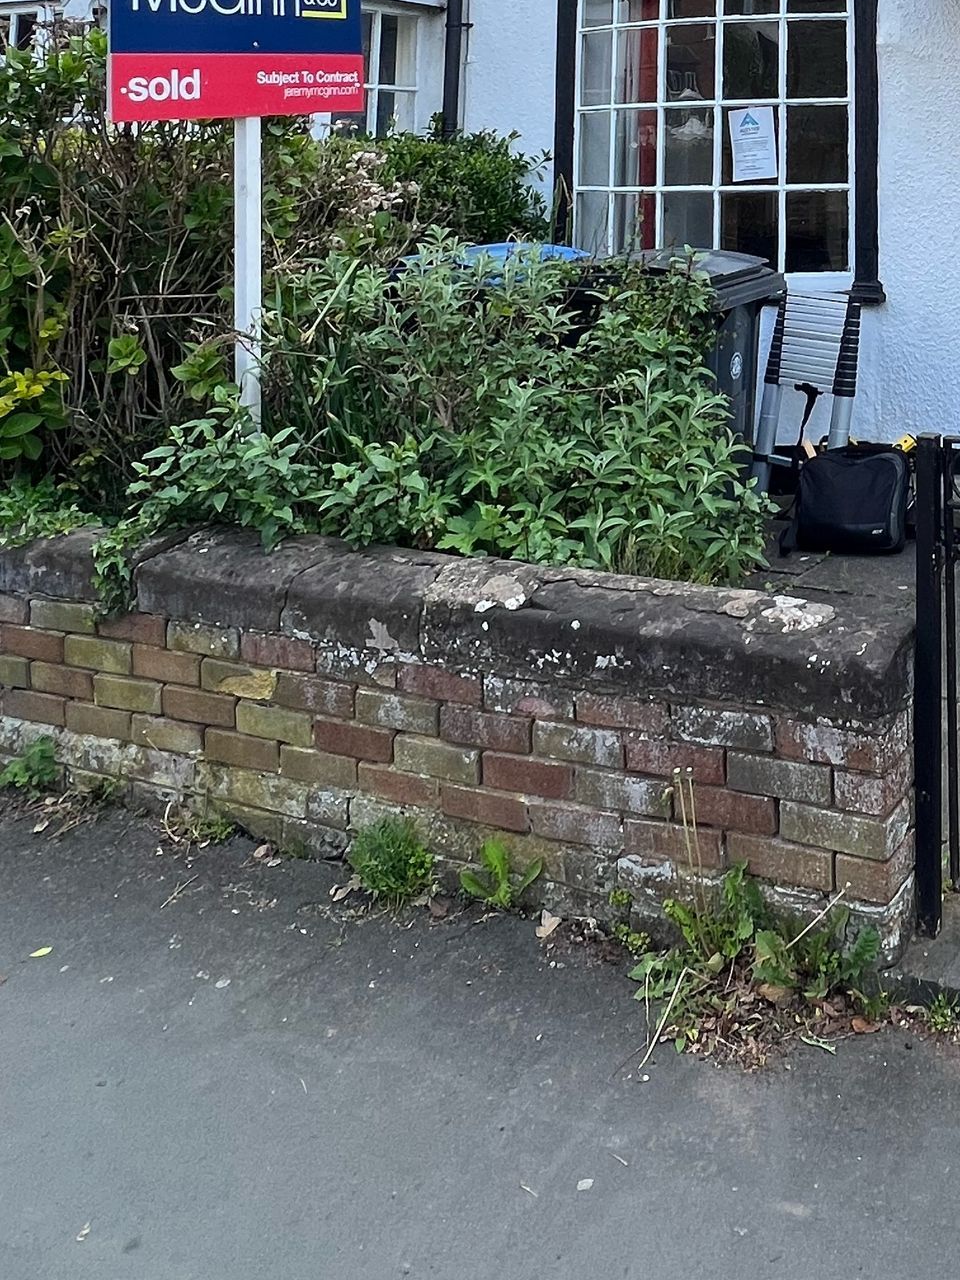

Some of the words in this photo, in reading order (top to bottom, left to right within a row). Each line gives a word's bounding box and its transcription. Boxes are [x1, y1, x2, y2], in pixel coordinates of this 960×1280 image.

[128, 68, 201, 101] sold
[256, 71, 300, 86] Subject
[301, 71, 314, 83] To
[316, 70, 358, 83] Contract
